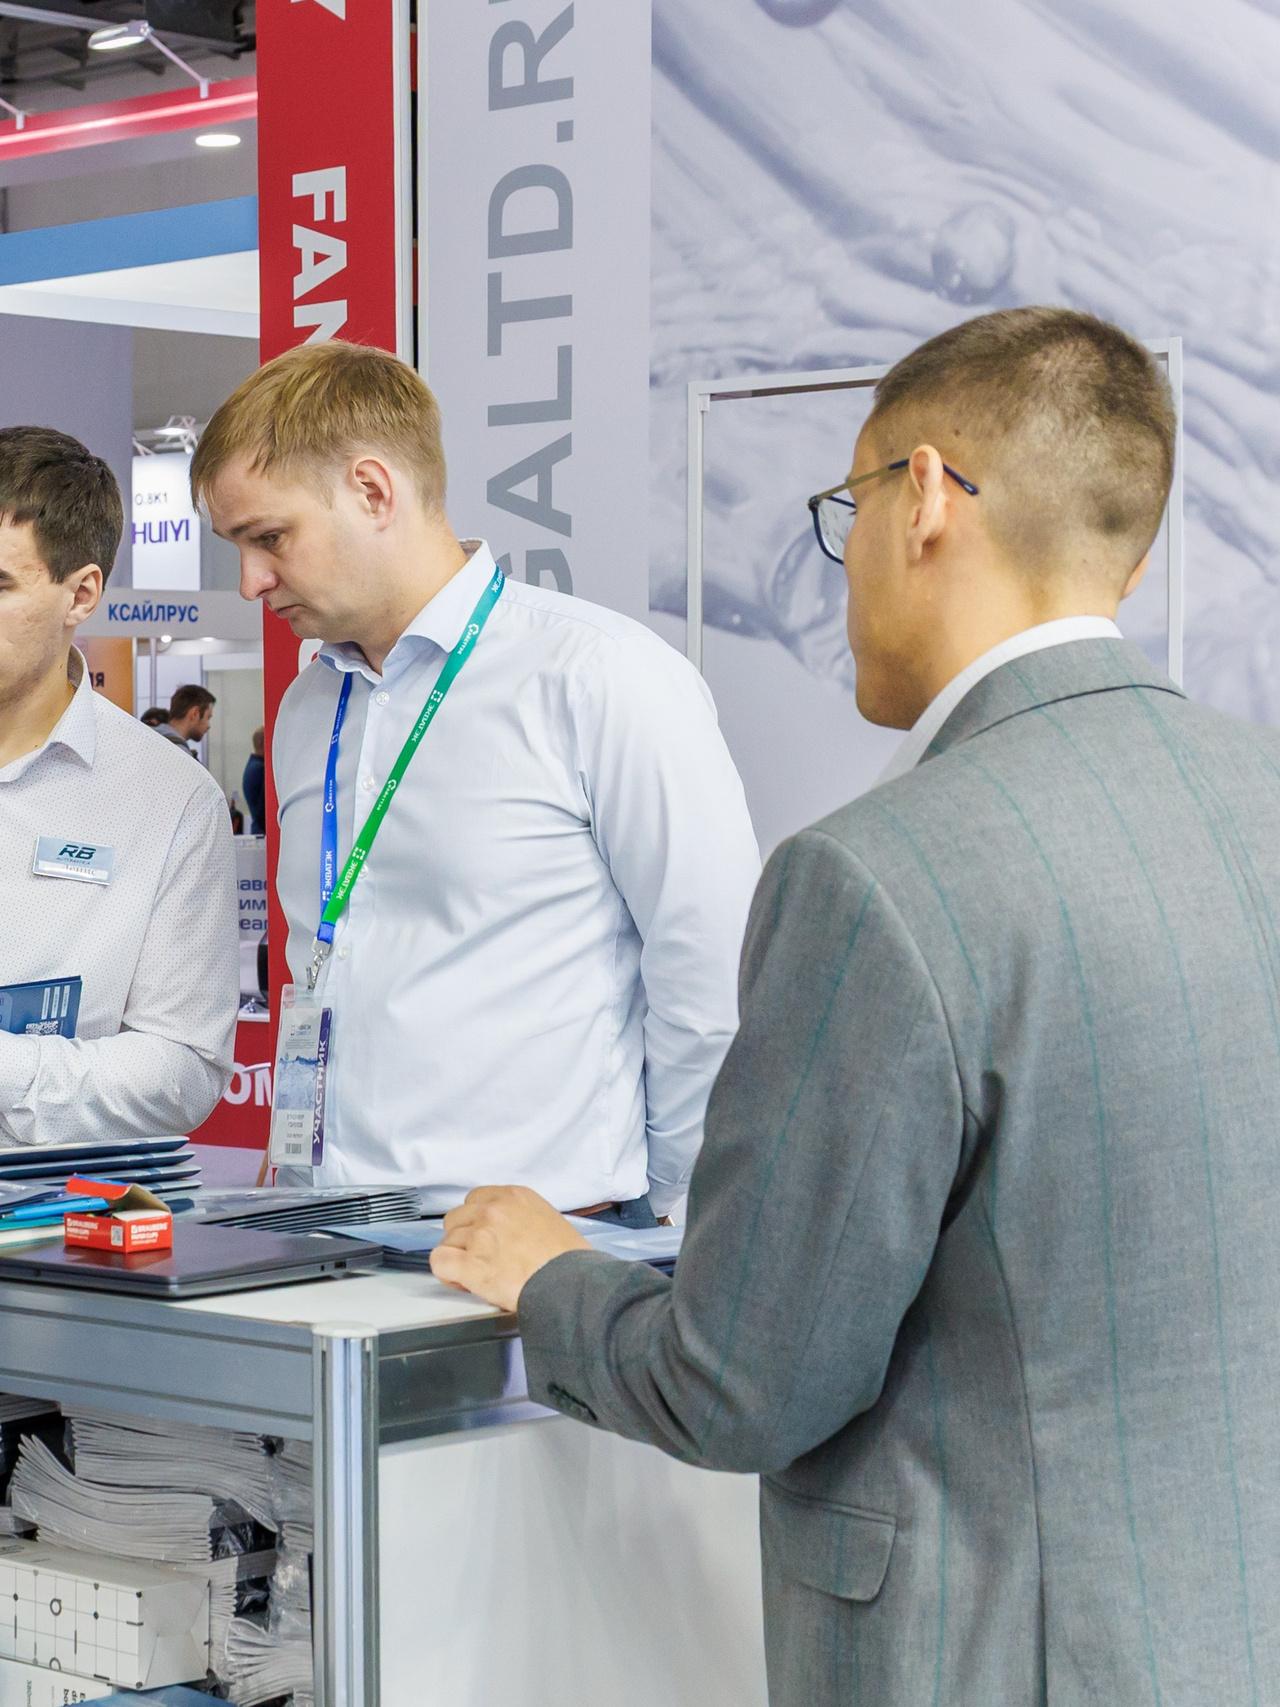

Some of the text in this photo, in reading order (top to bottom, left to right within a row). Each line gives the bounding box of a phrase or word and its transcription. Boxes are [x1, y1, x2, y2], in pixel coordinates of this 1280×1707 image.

[292, 166, 348, 346] FAN
[487, 0, 574, 597] ALTD.R
[108, 600, 199, 622] КСАЙЛРУС
[58, 844, 97, 860] RB
[325, 850, 333, 889] ЭКВАТЭК
[336, 861, 359, 900] ЭКВАТЭК
[313, 1040, 326, 1144] УЧАСТНИК
